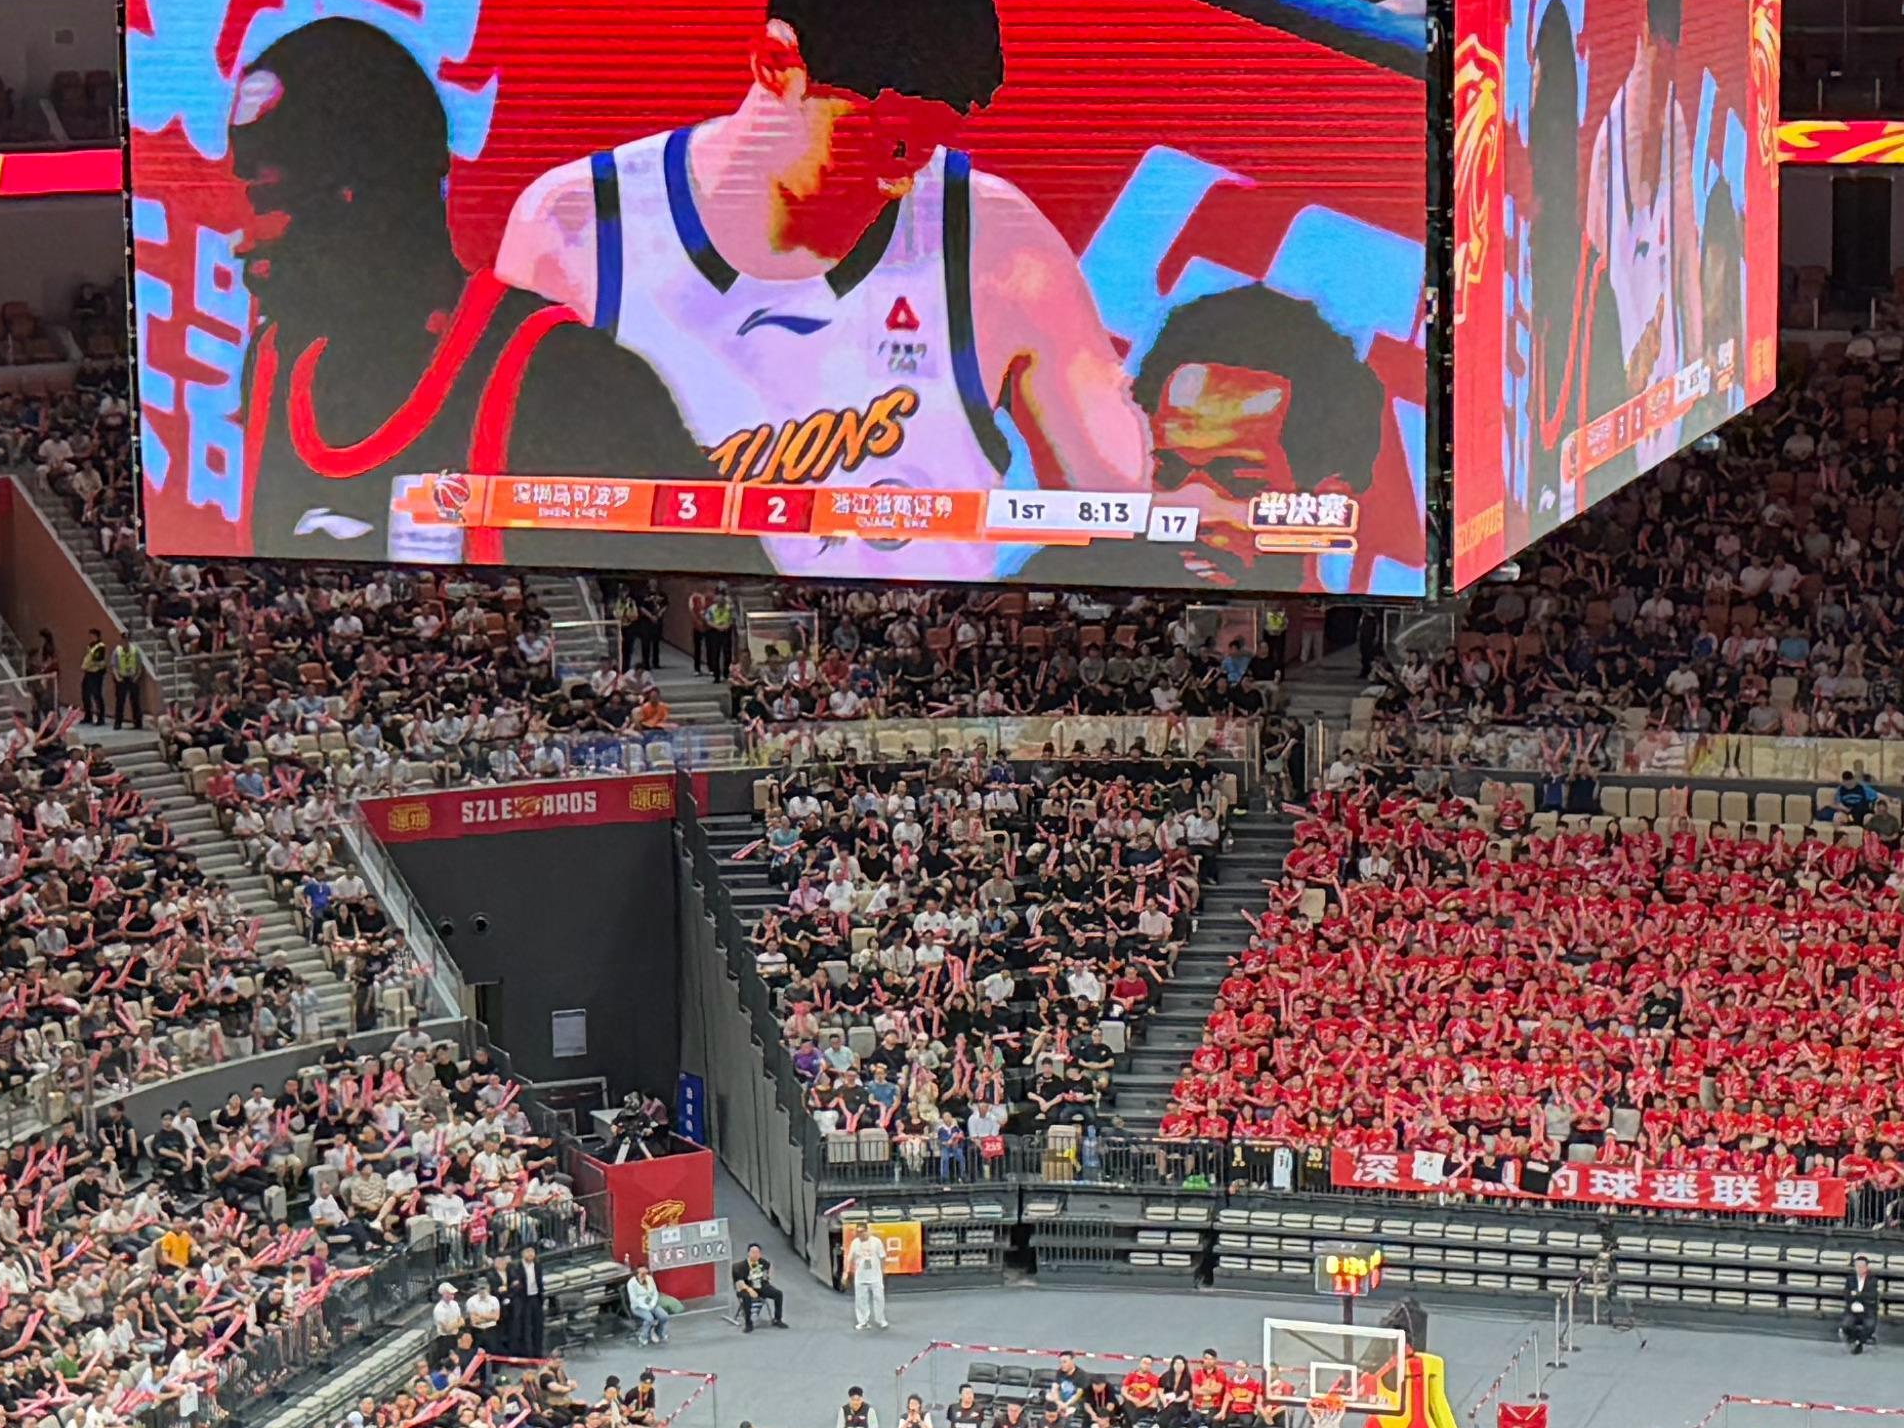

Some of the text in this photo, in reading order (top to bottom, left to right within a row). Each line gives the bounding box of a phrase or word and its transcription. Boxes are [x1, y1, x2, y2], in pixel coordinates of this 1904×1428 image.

[678, 491, 697, 519] 3
[767, 495, 787, 524] 2
[1008, 499, 1130, 523] 1ST 8:13
[1256, 491, 1351, 526] 半决赛
[1162, 515, 1187, 534] 17
[461, 791, 598, 824] SZLEARDS
